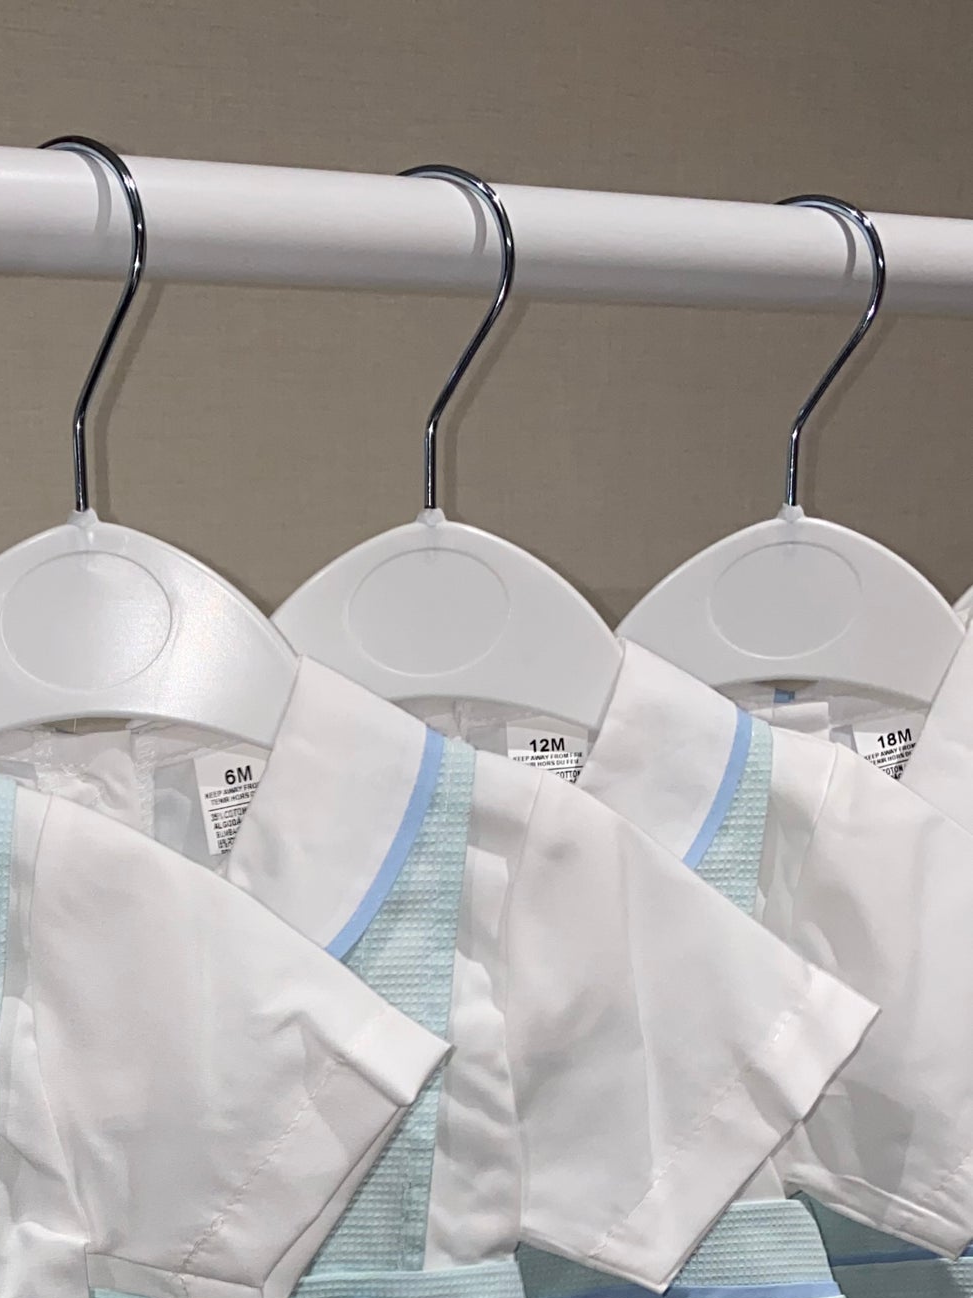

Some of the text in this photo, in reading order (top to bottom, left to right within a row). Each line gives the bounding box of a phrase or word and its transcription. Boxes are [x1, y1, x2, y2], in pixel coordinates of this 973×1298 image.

[529, 737, 565, 753] 12M
[877, 728, 912, 748] 18M
[880, 748, 898, 756] AWAY
[225, 765, 253, 785] 6M
[243, 781, 259, 791] FRO
